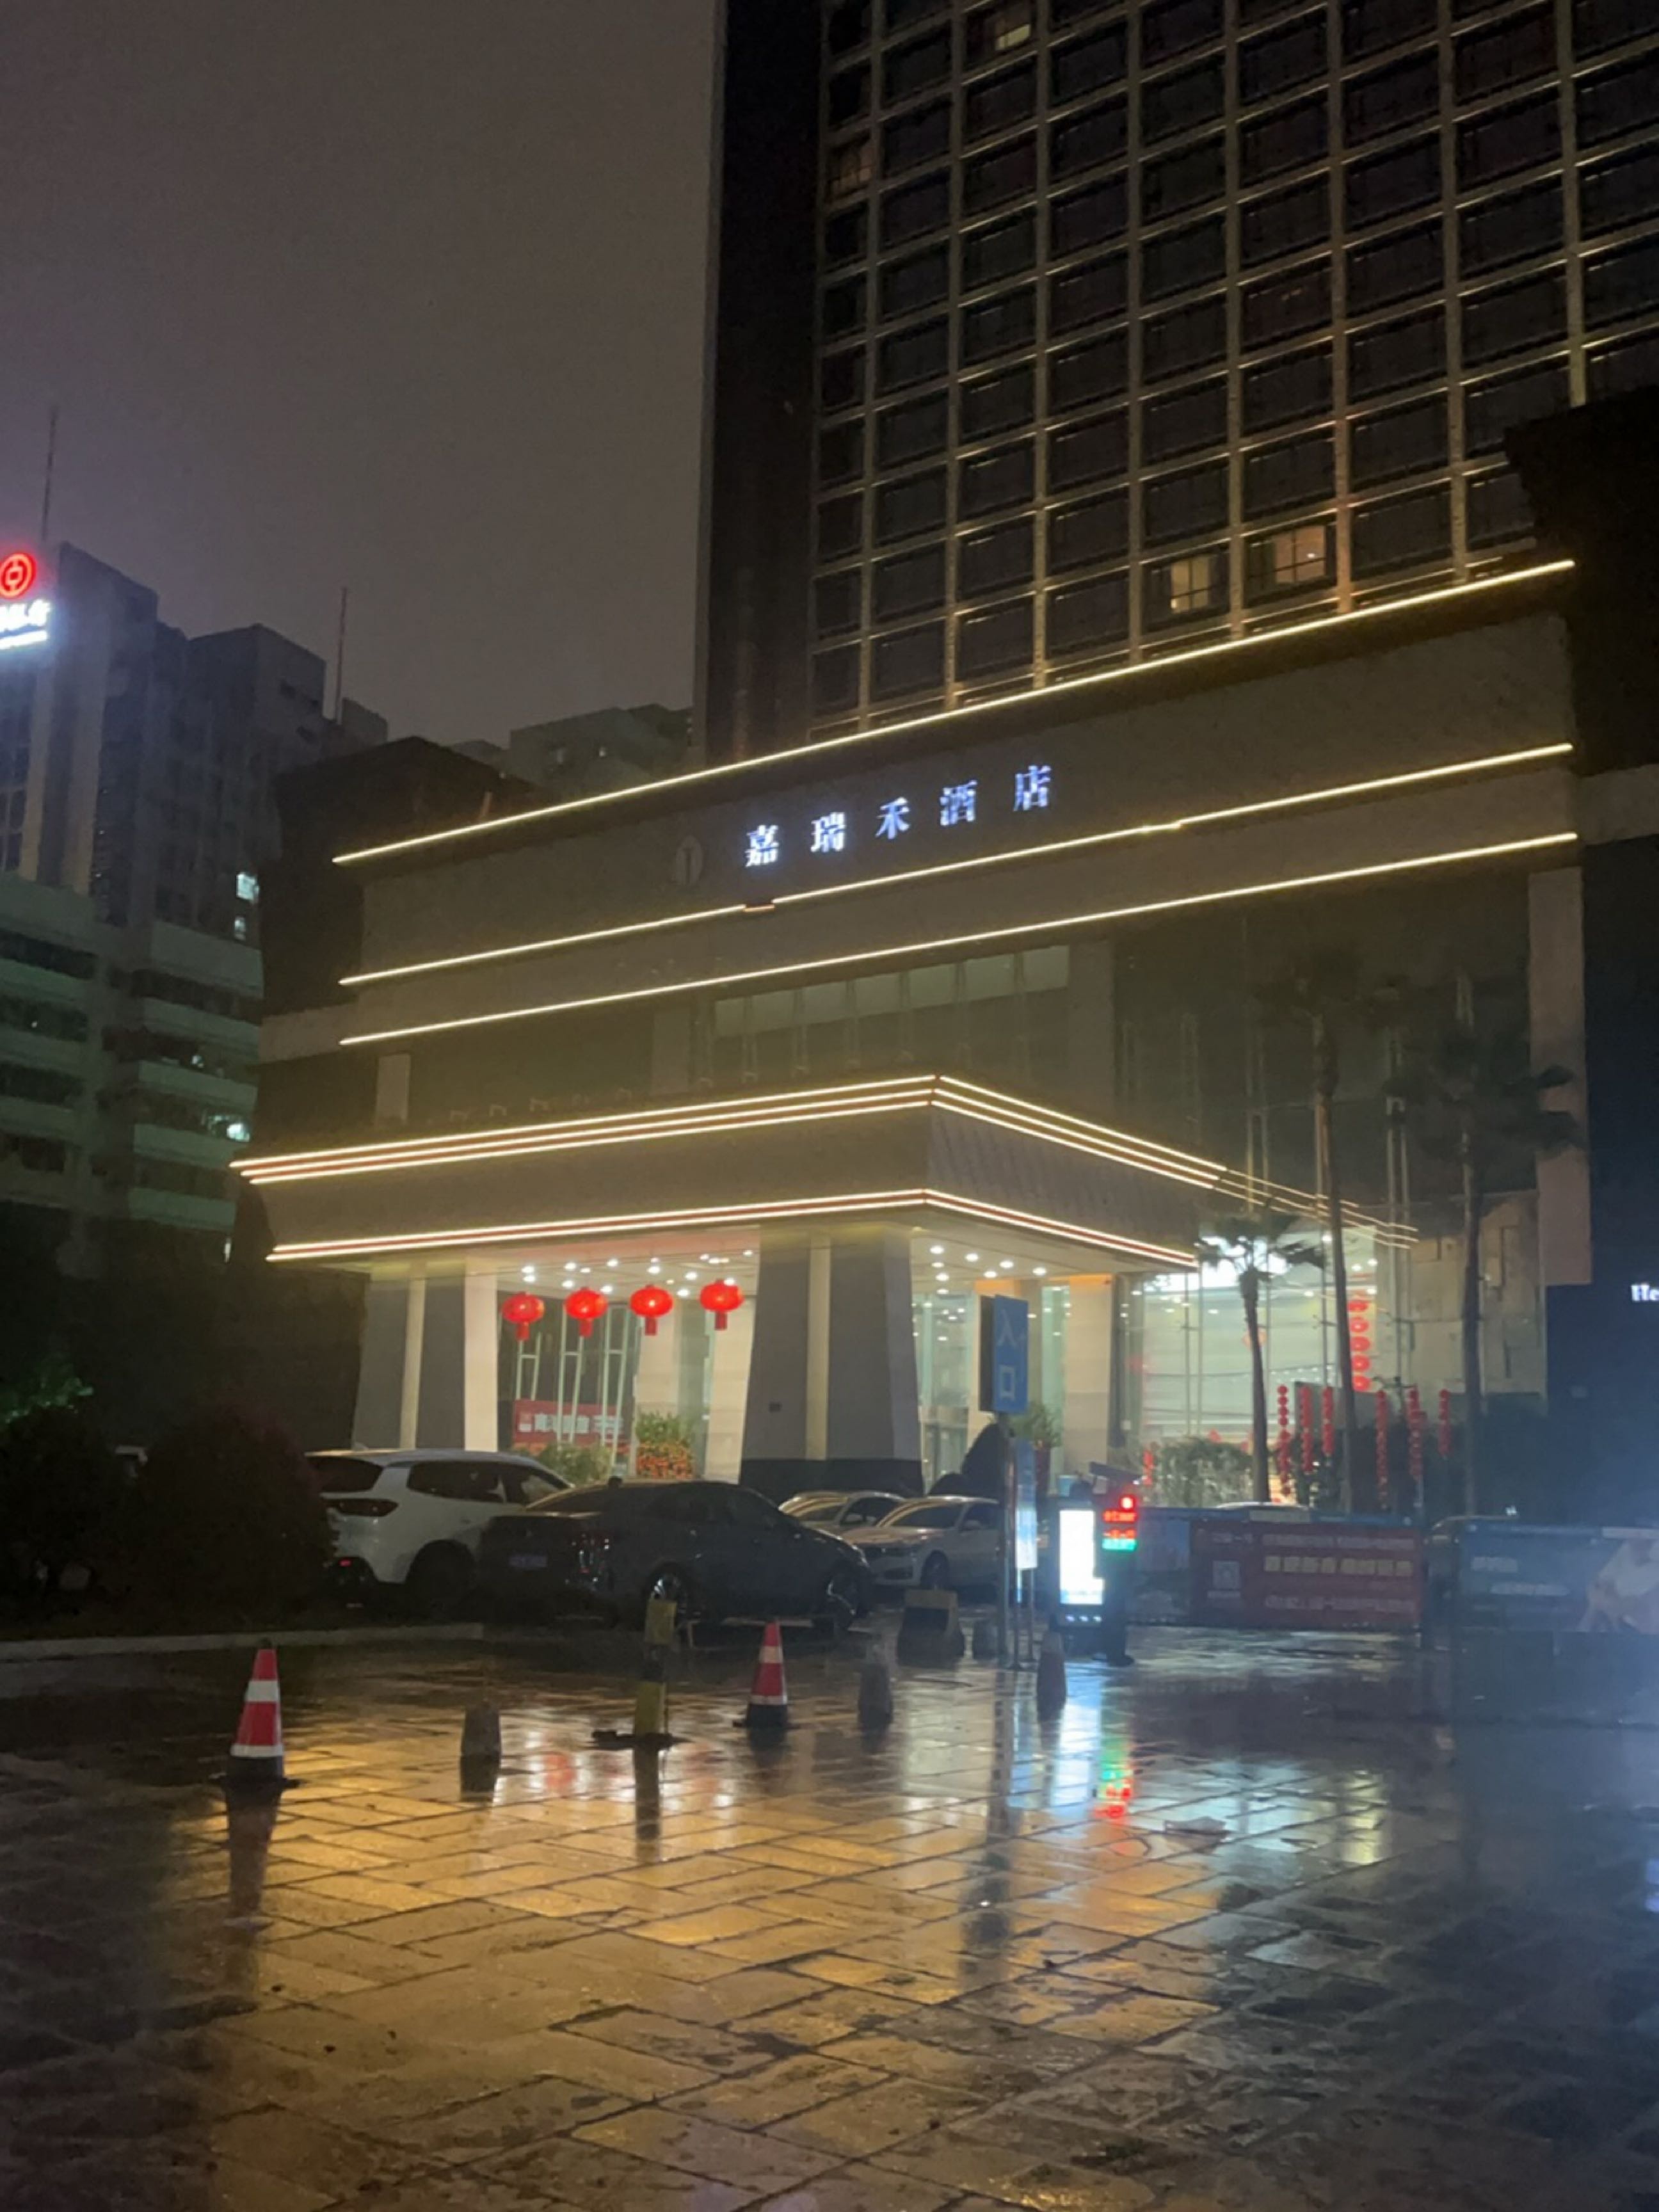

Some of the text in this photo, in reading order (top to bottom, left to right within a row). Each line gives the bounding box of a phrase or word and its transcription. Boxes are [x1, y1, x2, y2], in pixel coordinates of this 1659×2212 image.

[746, 765, 1052, 867] 嘉瑞禾酒店
[996, 1308, 1018, 1402] 入口
